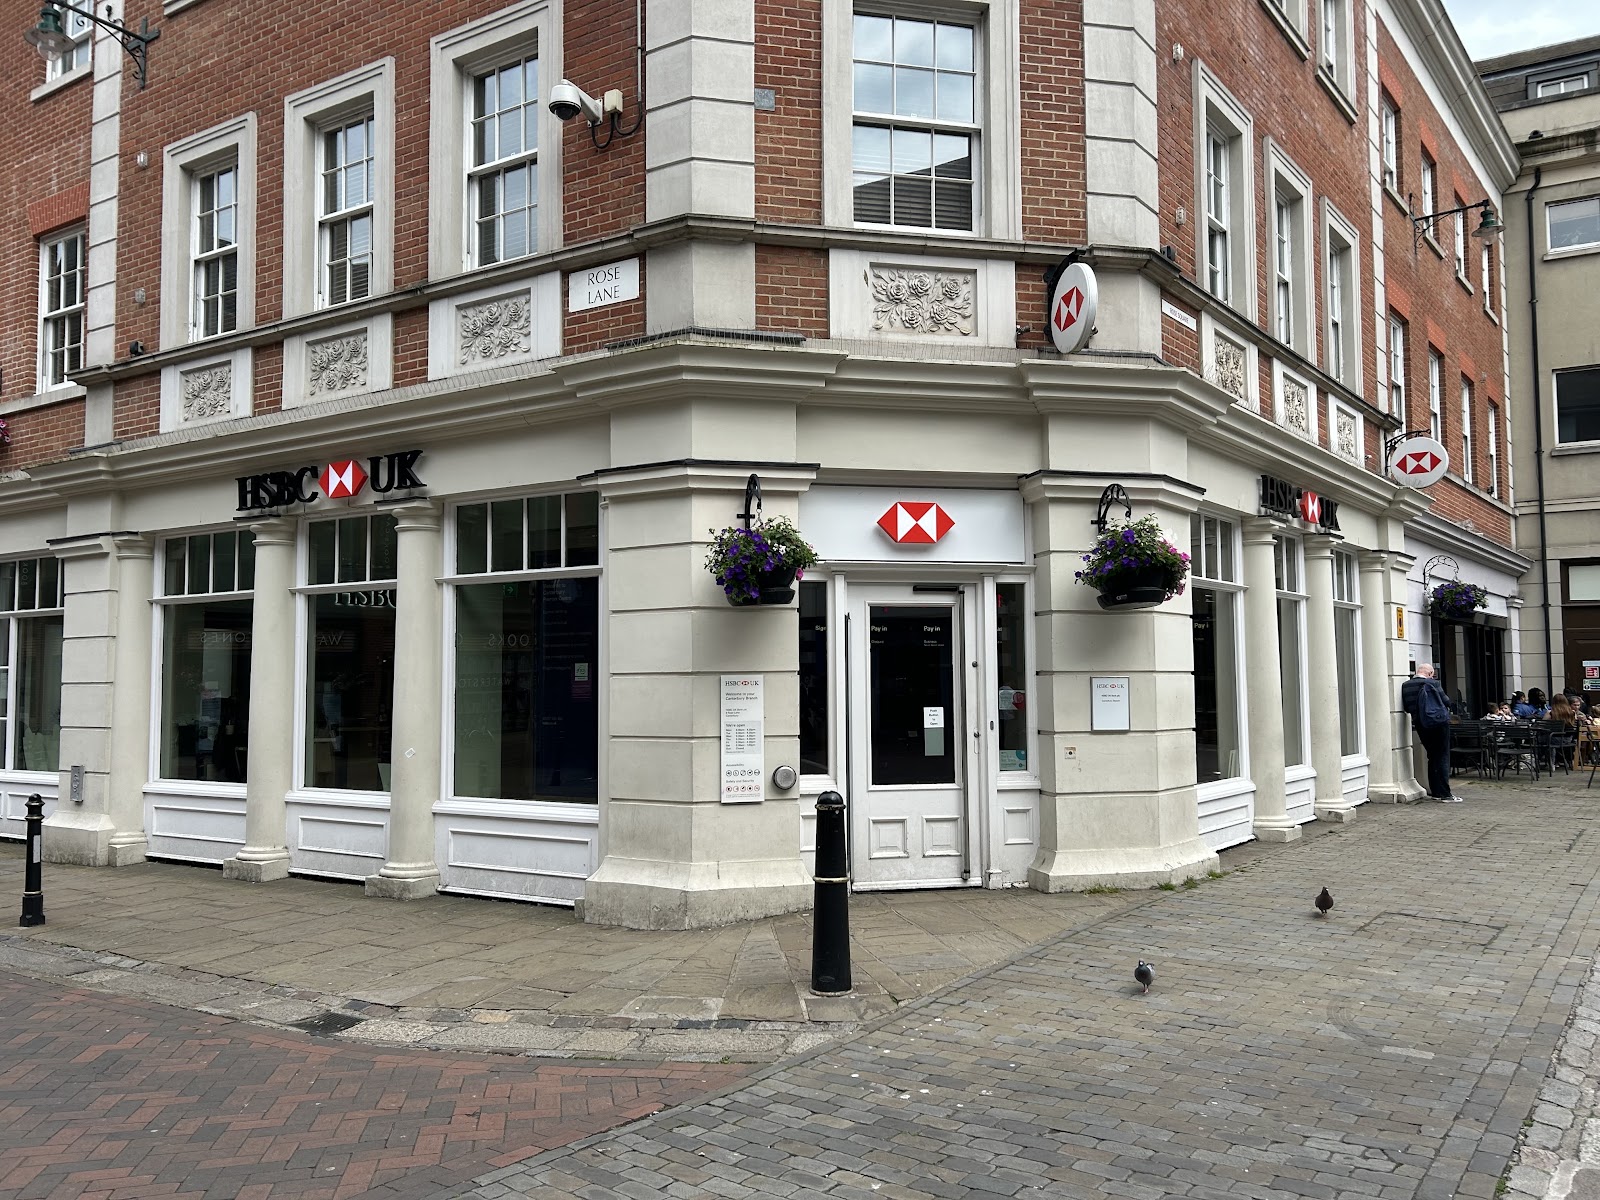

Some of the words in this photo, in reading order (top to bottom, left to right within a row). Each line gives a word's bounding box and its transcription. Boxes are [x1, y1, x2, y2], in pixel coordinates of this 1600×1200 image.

[587, 266, 620, 286] ROSE
[588, 285, 620, 304] LANE
[235, 465, 319, 511] HSBC
[367, 450, 427, 493] UK
[1261, 475, 1302, 518] HSBC
[1318, 497, 1341, 531] UK
[871, 625, 881, 633] Pay
[923, 625, 934, 633] Pay
